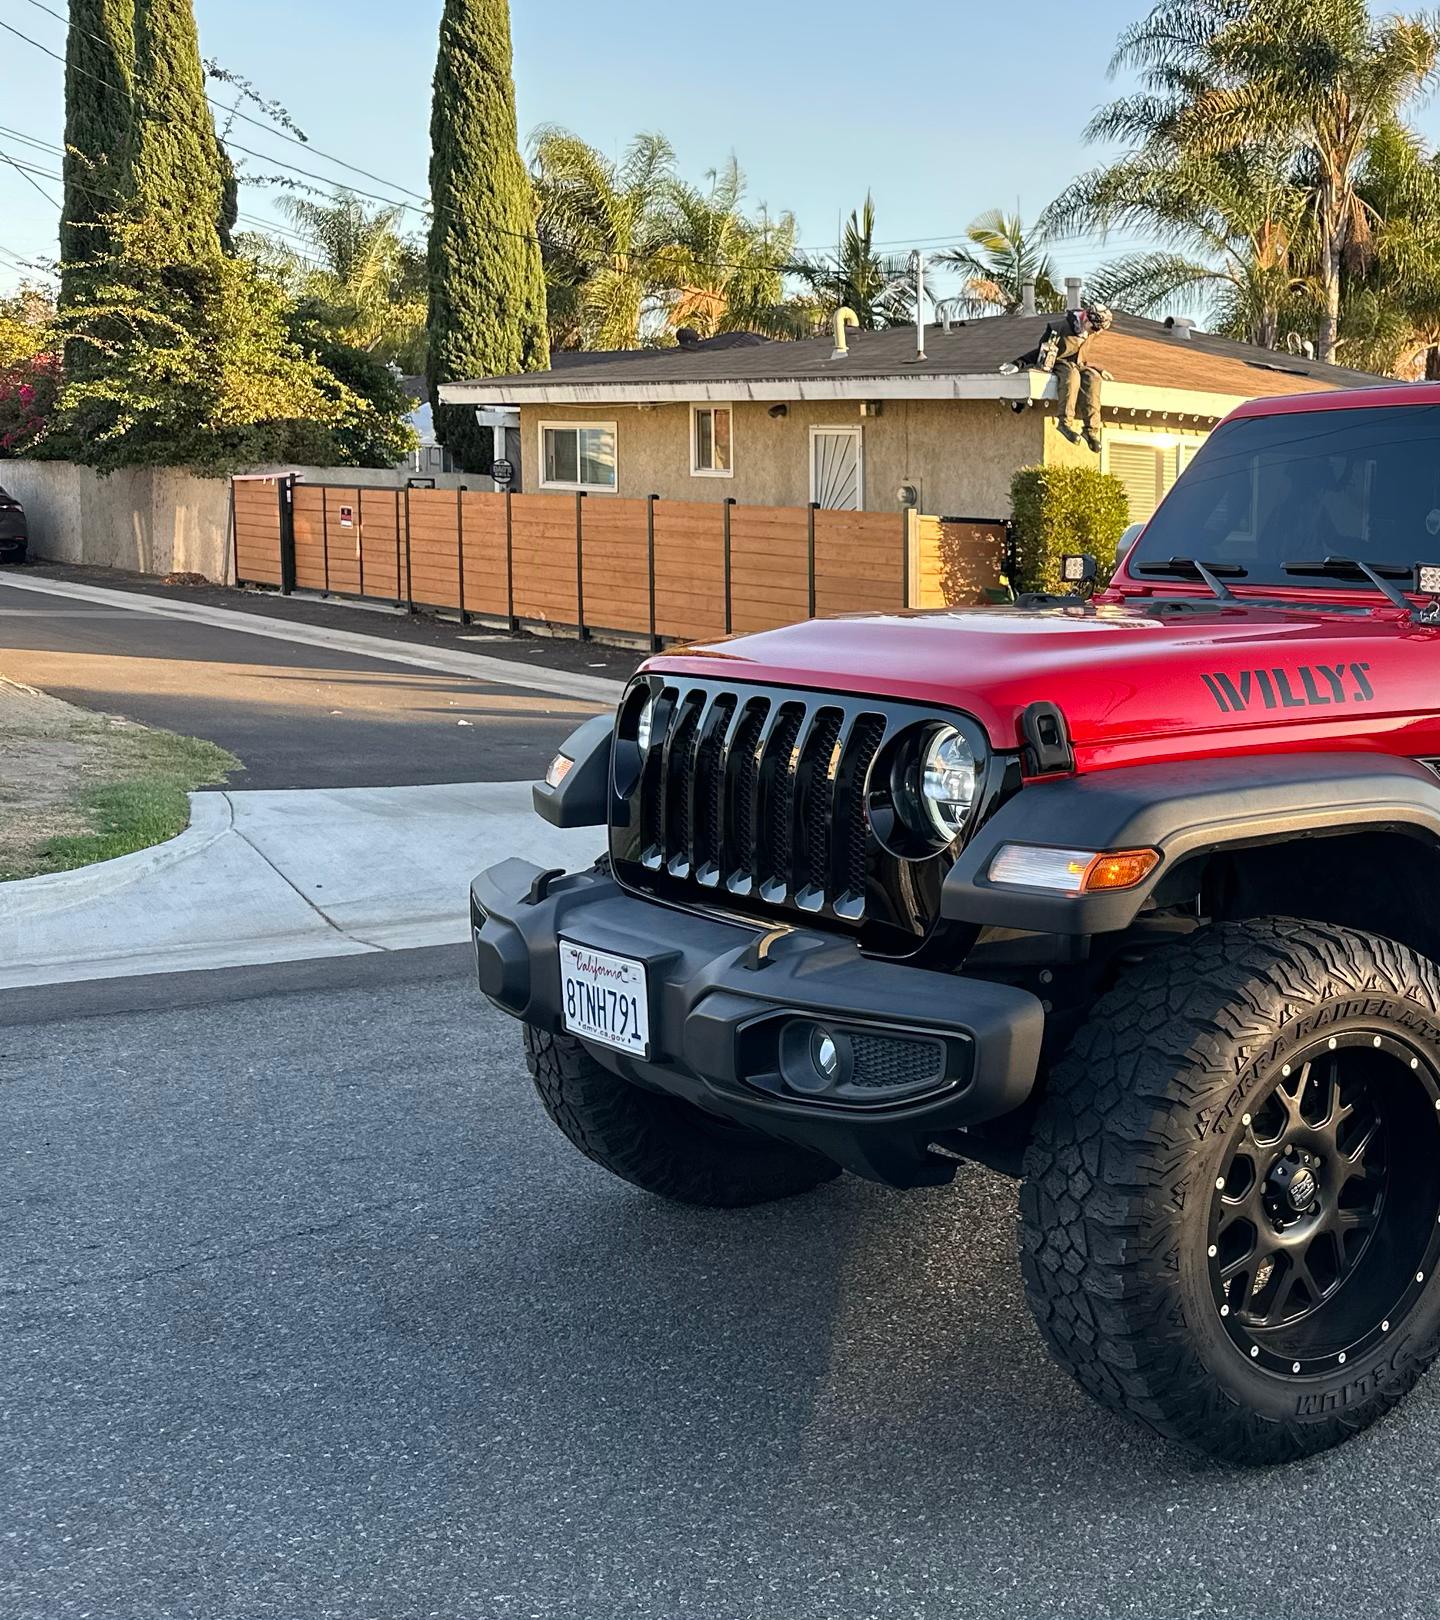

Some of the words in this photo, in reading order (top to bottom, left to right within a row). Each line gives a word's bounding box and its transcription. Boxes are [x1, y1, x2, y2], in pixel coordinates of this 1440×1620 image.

[1200, 662, 1374, 712] WILLYS
[576, 952, 629, 983] California
[567, 977, 642, 1041] 8TNH791
[582, 1023, 626, 1042] dmv.ca.gov
[1211, 1035, 1290, 1135] TERRA
[1296, 998, 1398, 1040] RAIDER
